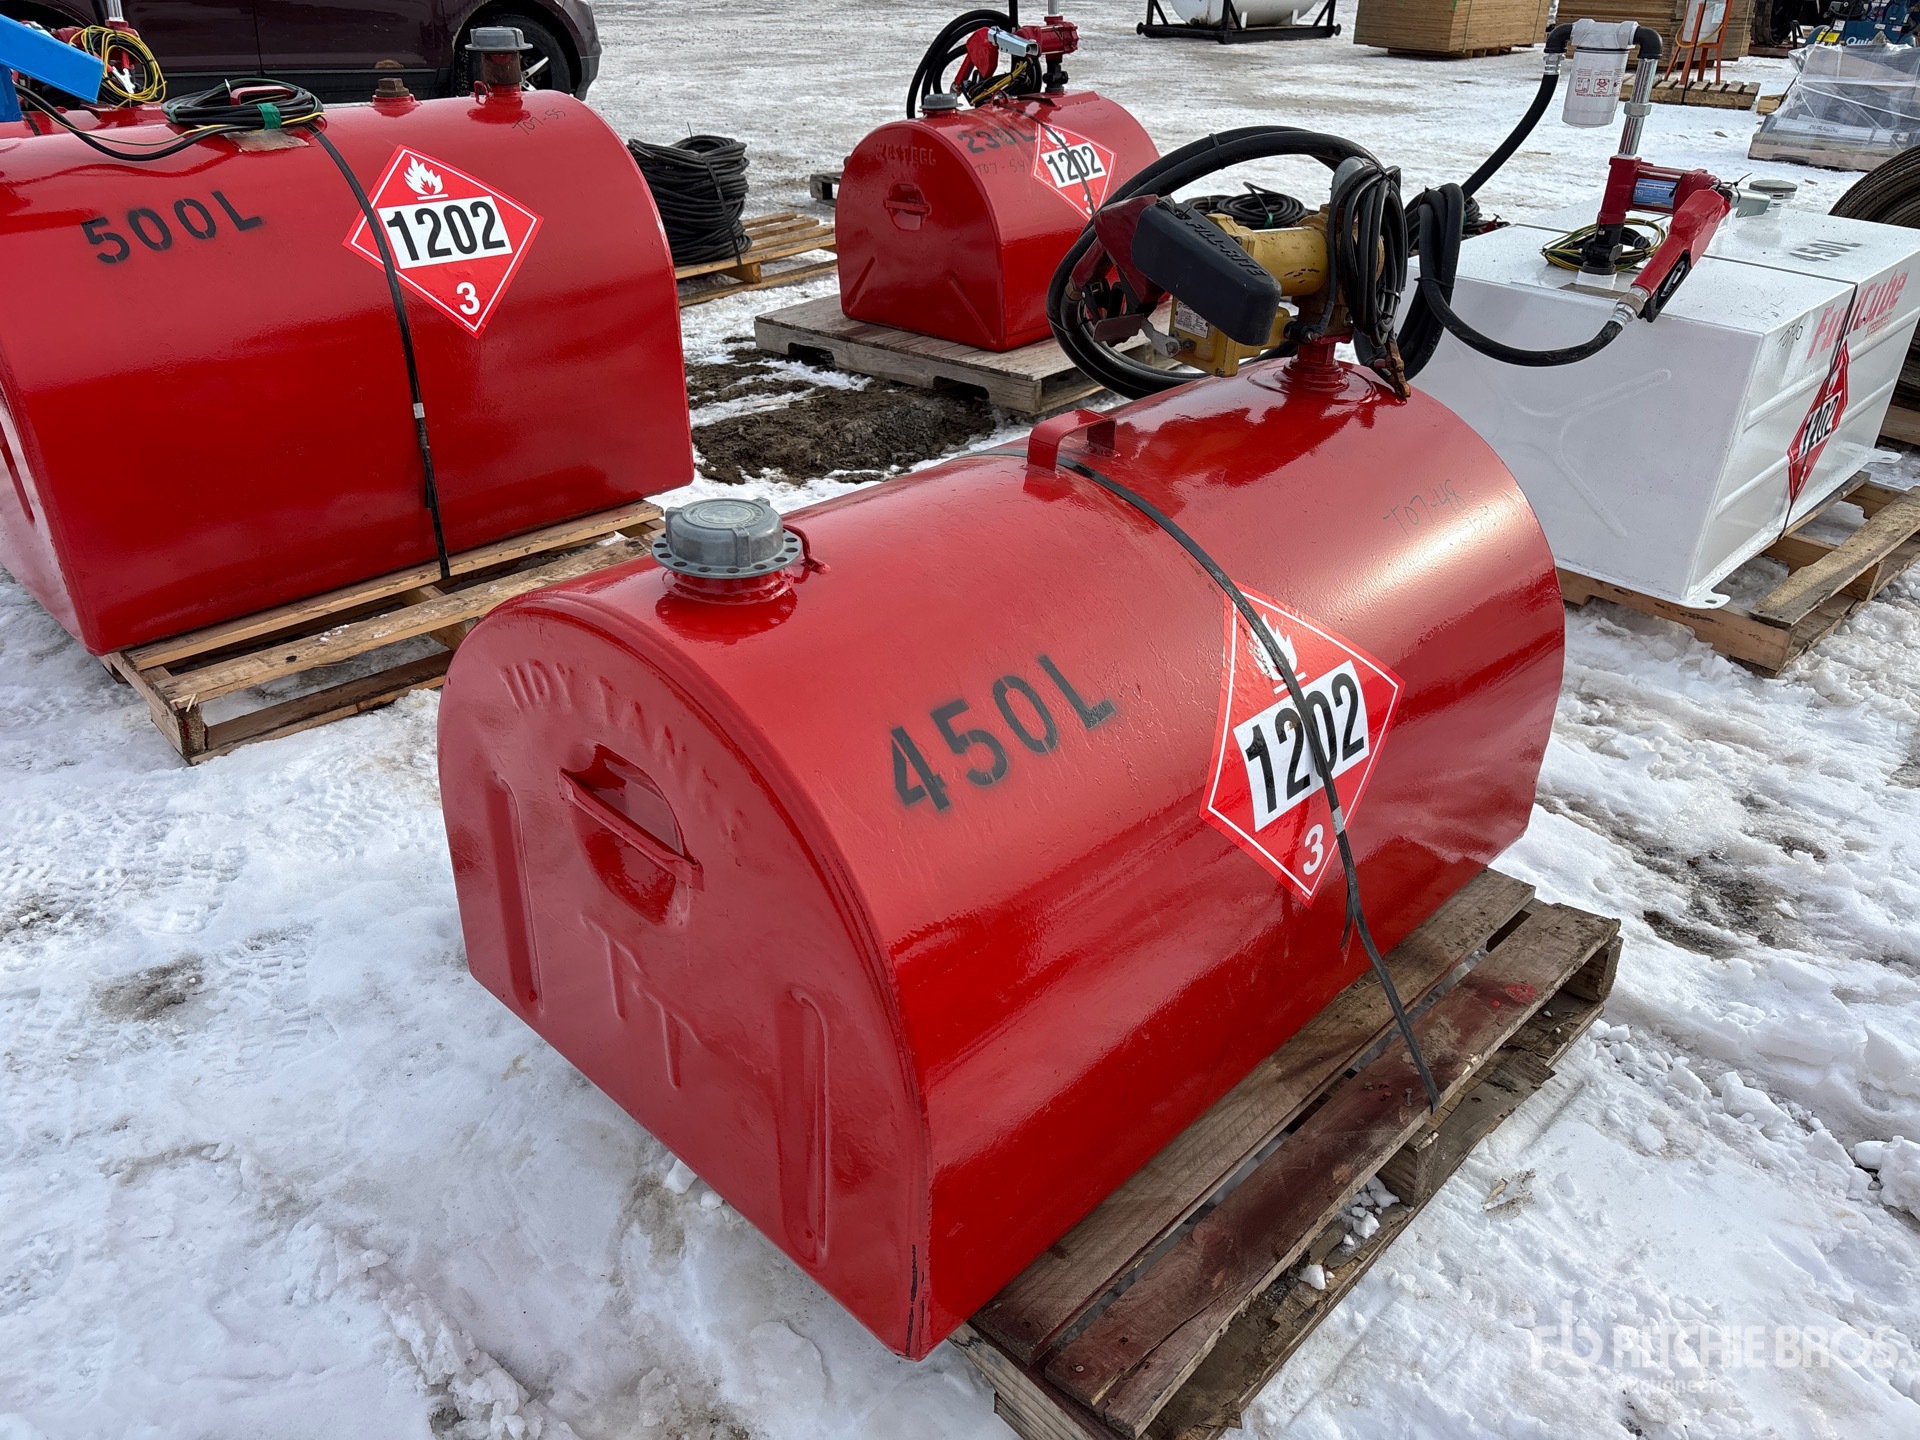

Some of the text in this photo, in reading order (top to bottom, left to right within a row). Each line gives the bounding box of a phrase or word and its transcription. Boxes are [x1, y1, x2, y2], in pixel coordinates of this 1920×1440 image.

[511, 108, 566, 136] T07-55
[1046, 145, 1103, 183] 1202
[80, 190, 264, 264] 500L
[386, 200, 507, 262] 1202
[1185, 221, 1269, 277] FILL-RITE
[1788, 239, 1863, 262] 450L
[456, 282, 481, 316] 3
[1800, 395, 1839, 457] 1202
[891, 655, 1116, 812] 450L
[1244, 672, 1365, 814] 1202
[1303, 823, 1324, 875] 3
